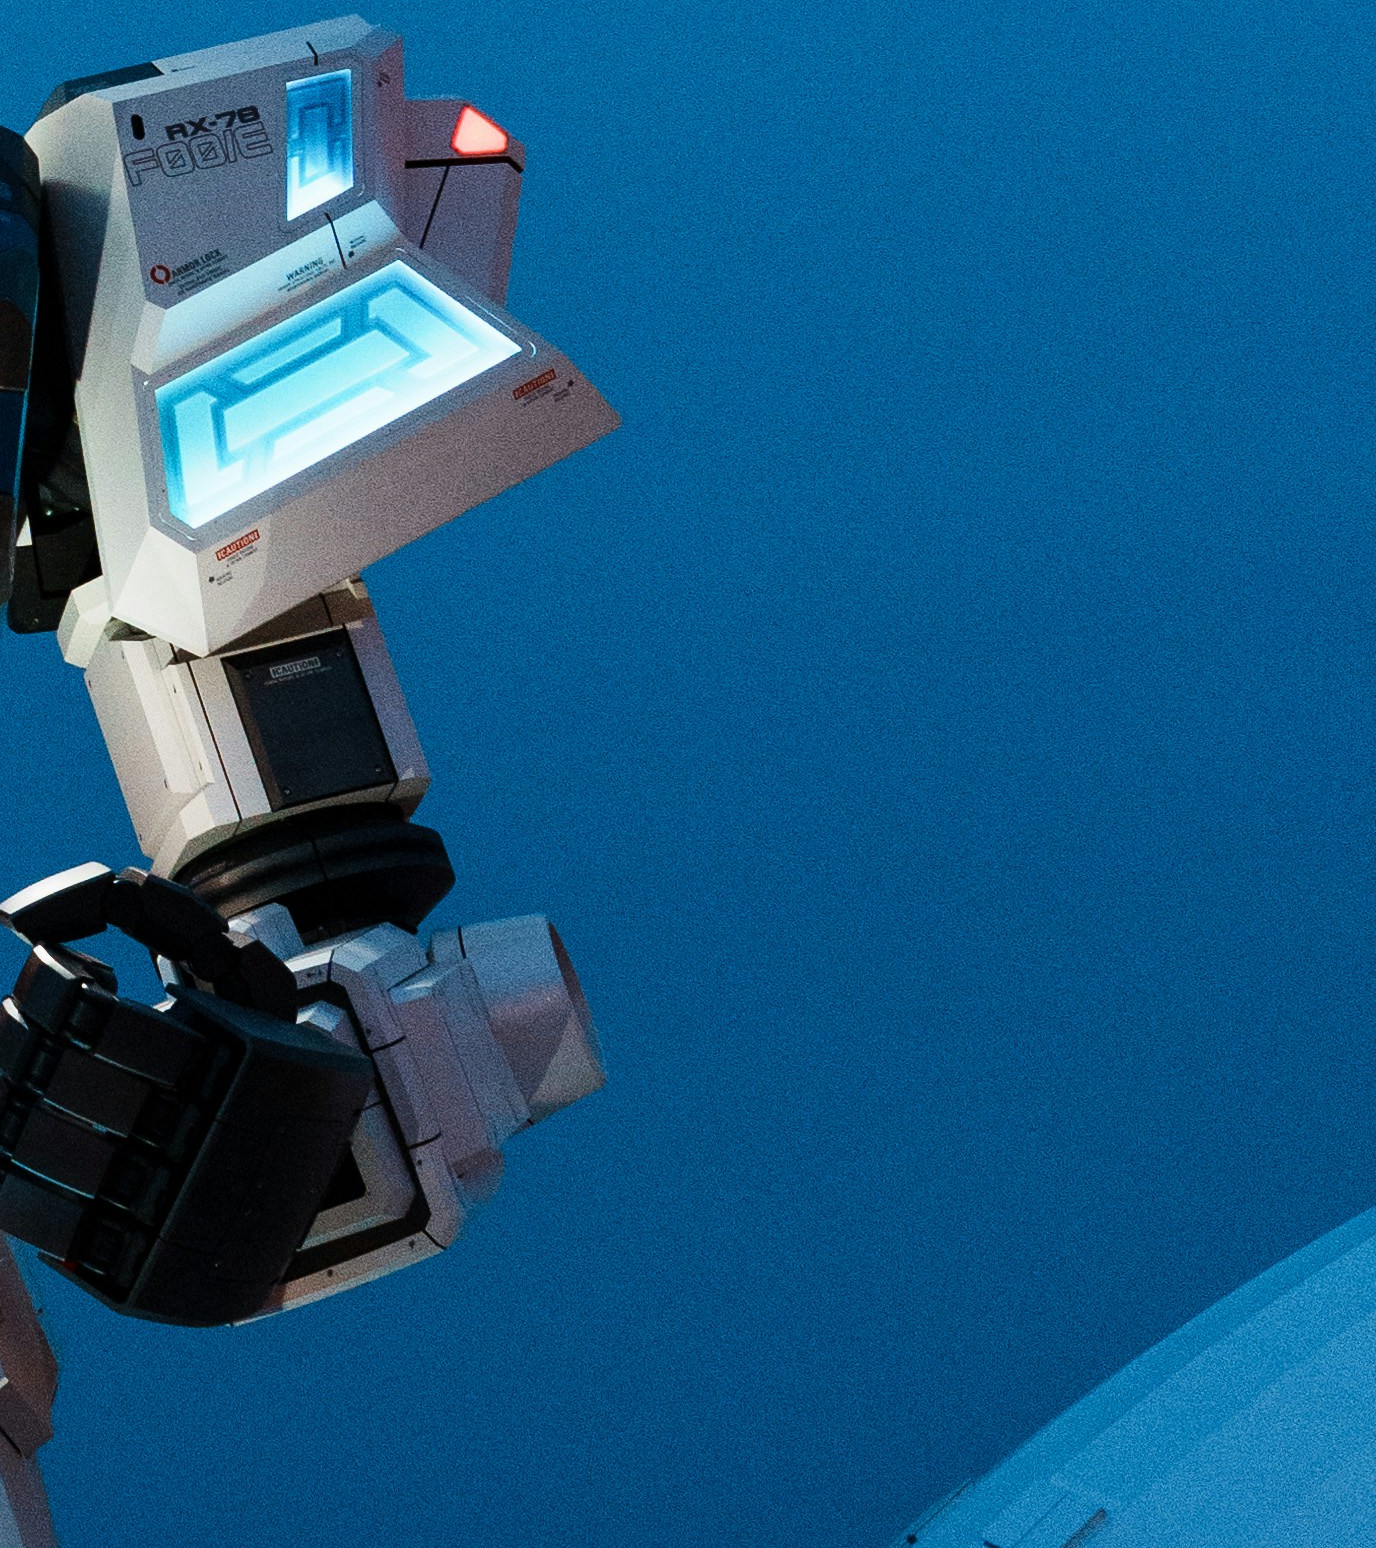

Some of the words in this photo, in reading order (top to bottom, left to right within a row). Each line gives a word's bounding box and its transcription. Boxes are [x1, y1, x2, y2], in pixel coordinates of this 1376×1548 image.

[164, 105, 261, 141] RX-78
[171, 257, 202, 278] ARMOR
[201, 248, 221, 267] LOCK
[285, 257, 325, 281] WARNING
